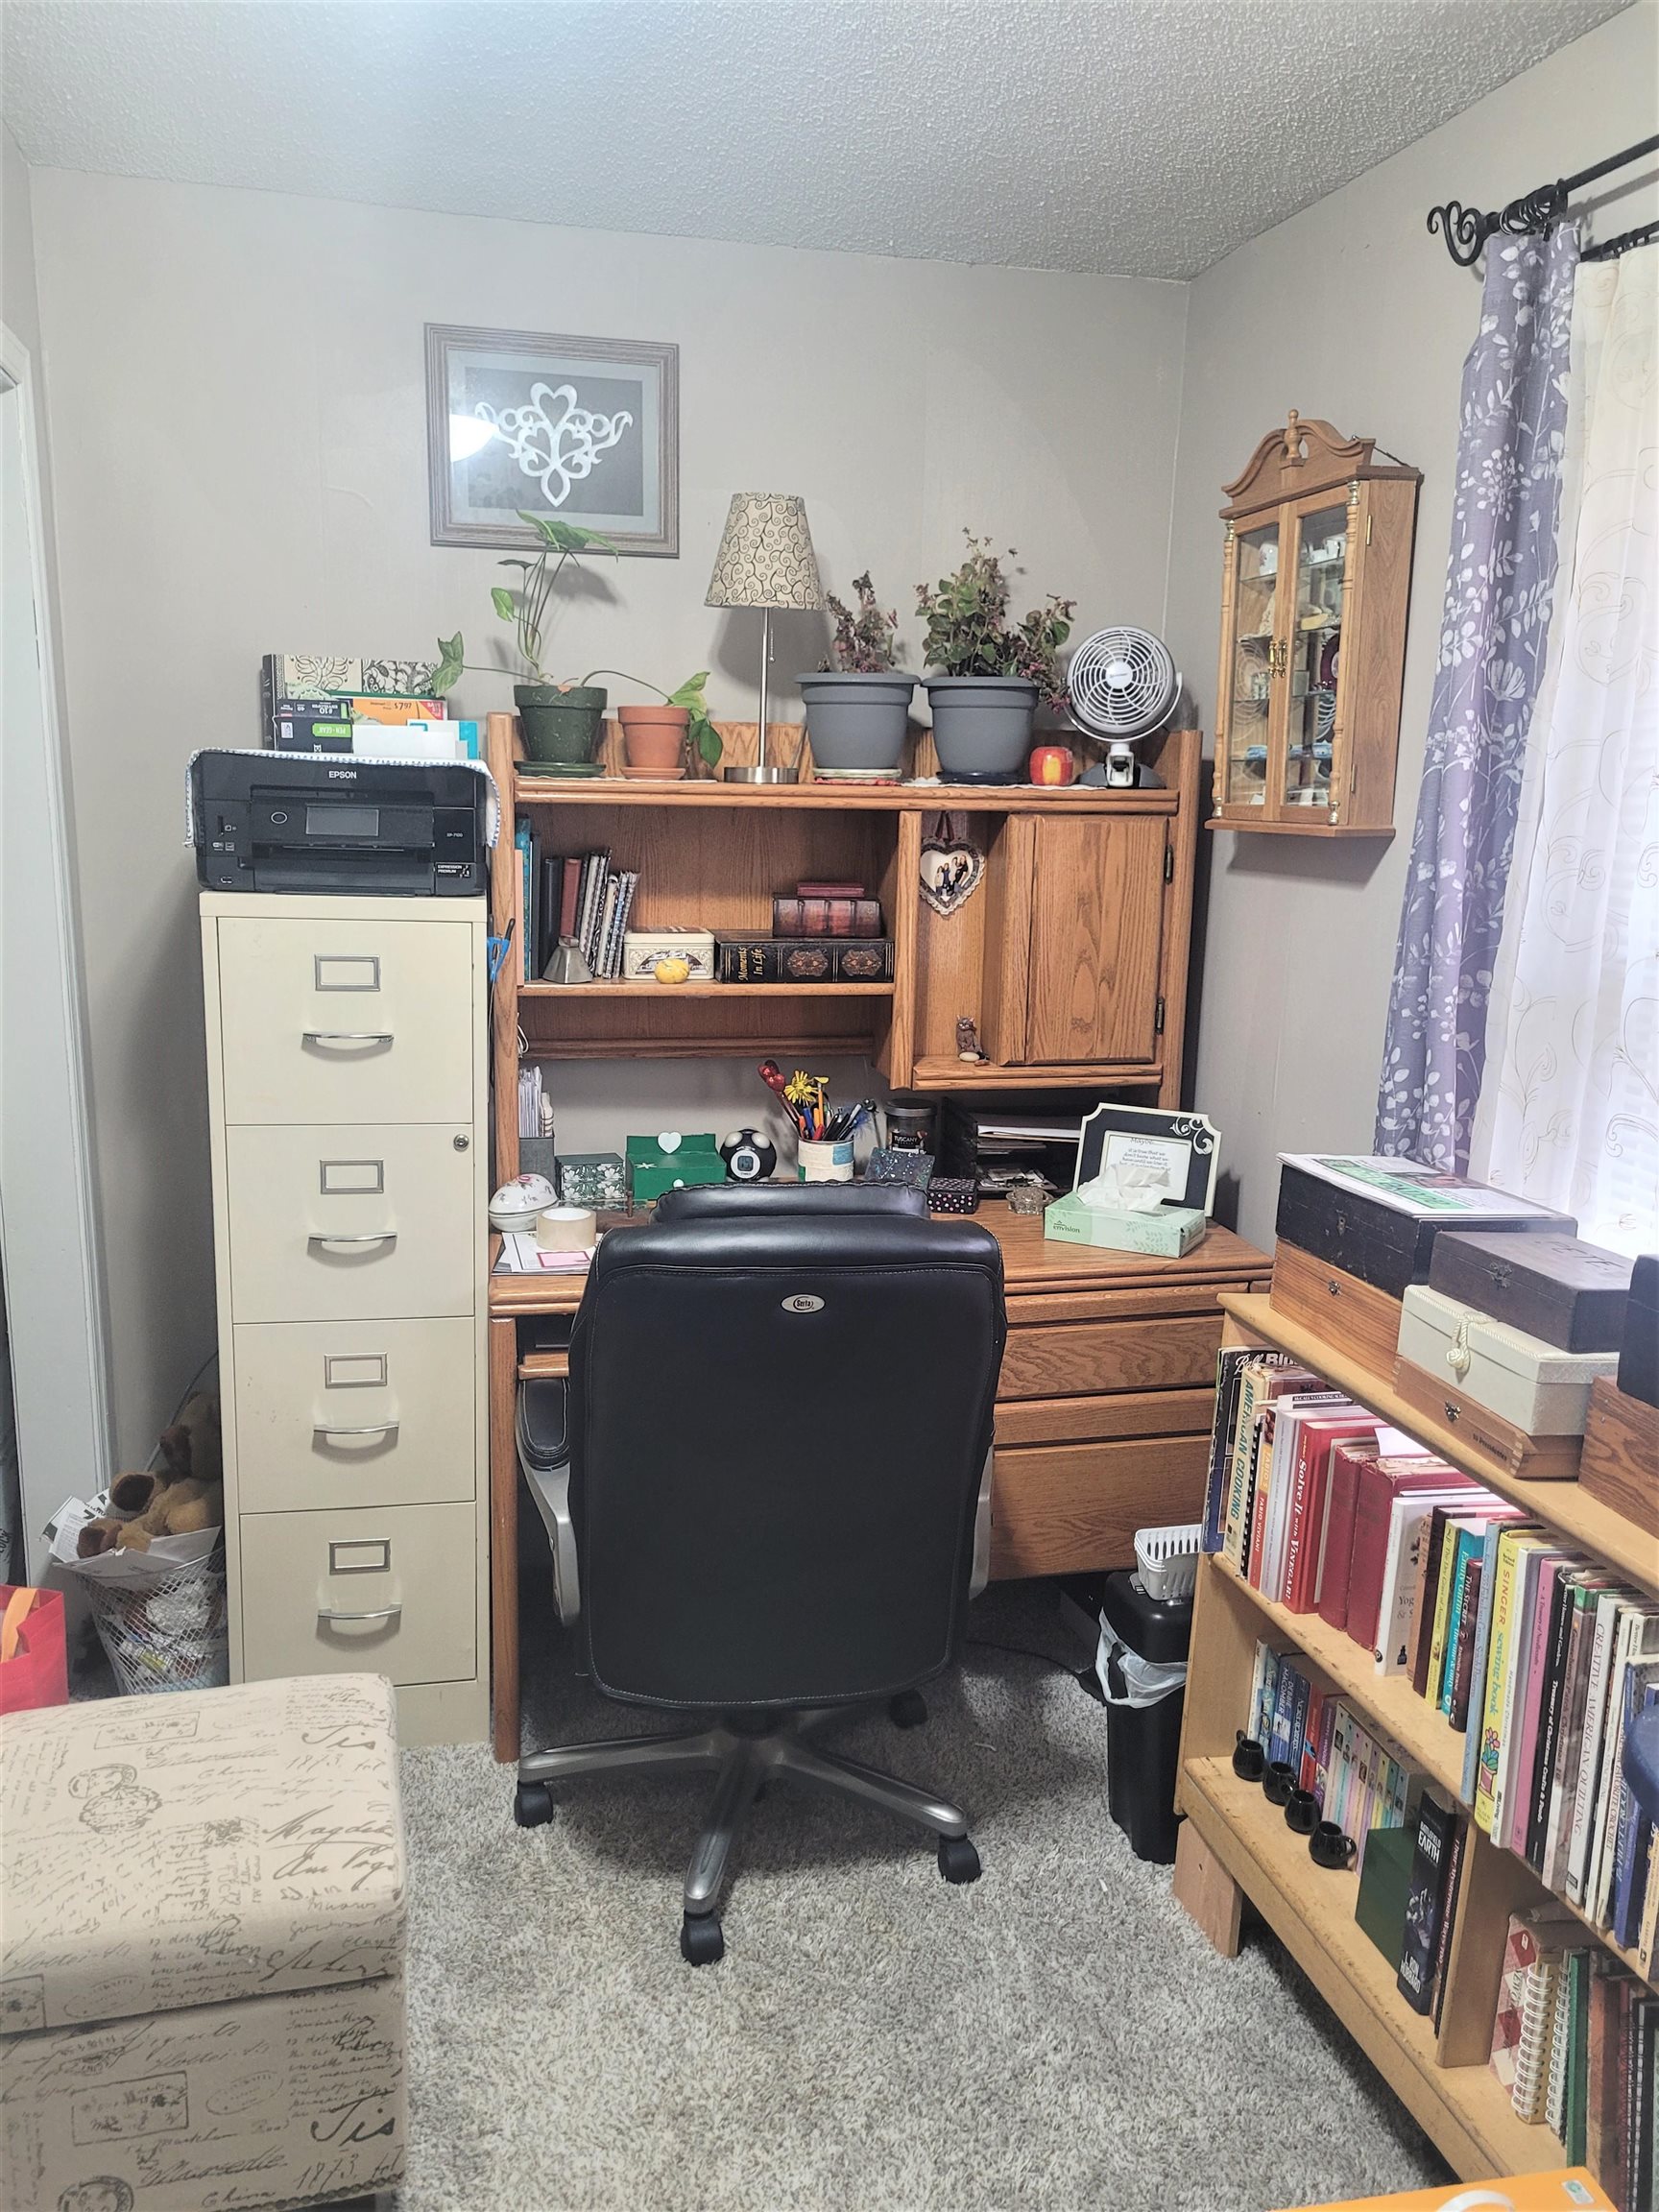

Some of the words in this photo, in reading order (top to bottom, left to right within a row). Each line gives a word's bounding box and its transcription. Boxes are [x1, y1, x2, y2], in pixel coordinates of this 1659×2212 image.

[328, 770, 357, 779] EPSON
[737, 947, 749, 981] Moments
[751, 948, 766, 965] Life
[753, 966, 763, 975] In
[1052, 1224, 1080, 1234] envision
[1265, 1353, 1300, 1366] Blu
[1237, 1379, 1254, 1455] AMERAN
[1261, 1452, 1272, 1488] FABIO'S
[1294, 1458, 1308, 1502] Solve
[1229, 1457, 1245, 1520] COOKING
[1293, 1502, 1303, 1514] It
[1284, 1538, 1298, 1599] VINEGAR!
[1398, 1595, 1414, 1607] Yog
[1460, 1594, 1469, 1624] SECRET
[1498, 1570, 1510, 1624] SINGER
[1492, 1631, 1505, 1678] sewing
[1566, 1628, 1578, 1680] Gooseberry
[1589, 1623, 1605, 1691] CREATIVE
[1278, 1667, 1288, 1713] MACOMBER
[1445, 1669, 1454, 1689] only
[1488, 1679, 1501, 1715] book
[1548, 1680, 1558, 1714] Treasury
[1562, 1686, 1572, 1715] Patch
[1547, 1715, 1554, 1724] of
[1581, 1695, 1597, 1764] AMERICAN
[1542, 1725, 1553, 1765] Christmas
[1556, 1716, 1569, 1762] Christmas
[1539, 1766, 1549, 1791] Crafts
[1610, 1760, 1623, 1806] FAVORITE
[1573, 1768, 1588, 1837] QUILTING
[1417, 1830, 1440, 1863] EARTH
[1420, 1820, 1442, 1849] BATTLEFIELD
[1604, 1807, 1619, 1850] CROCHET
[1443, 1865, 1456, 1916] Mysterious
[1400, 1959, 1421, 1994] HUBBARD
